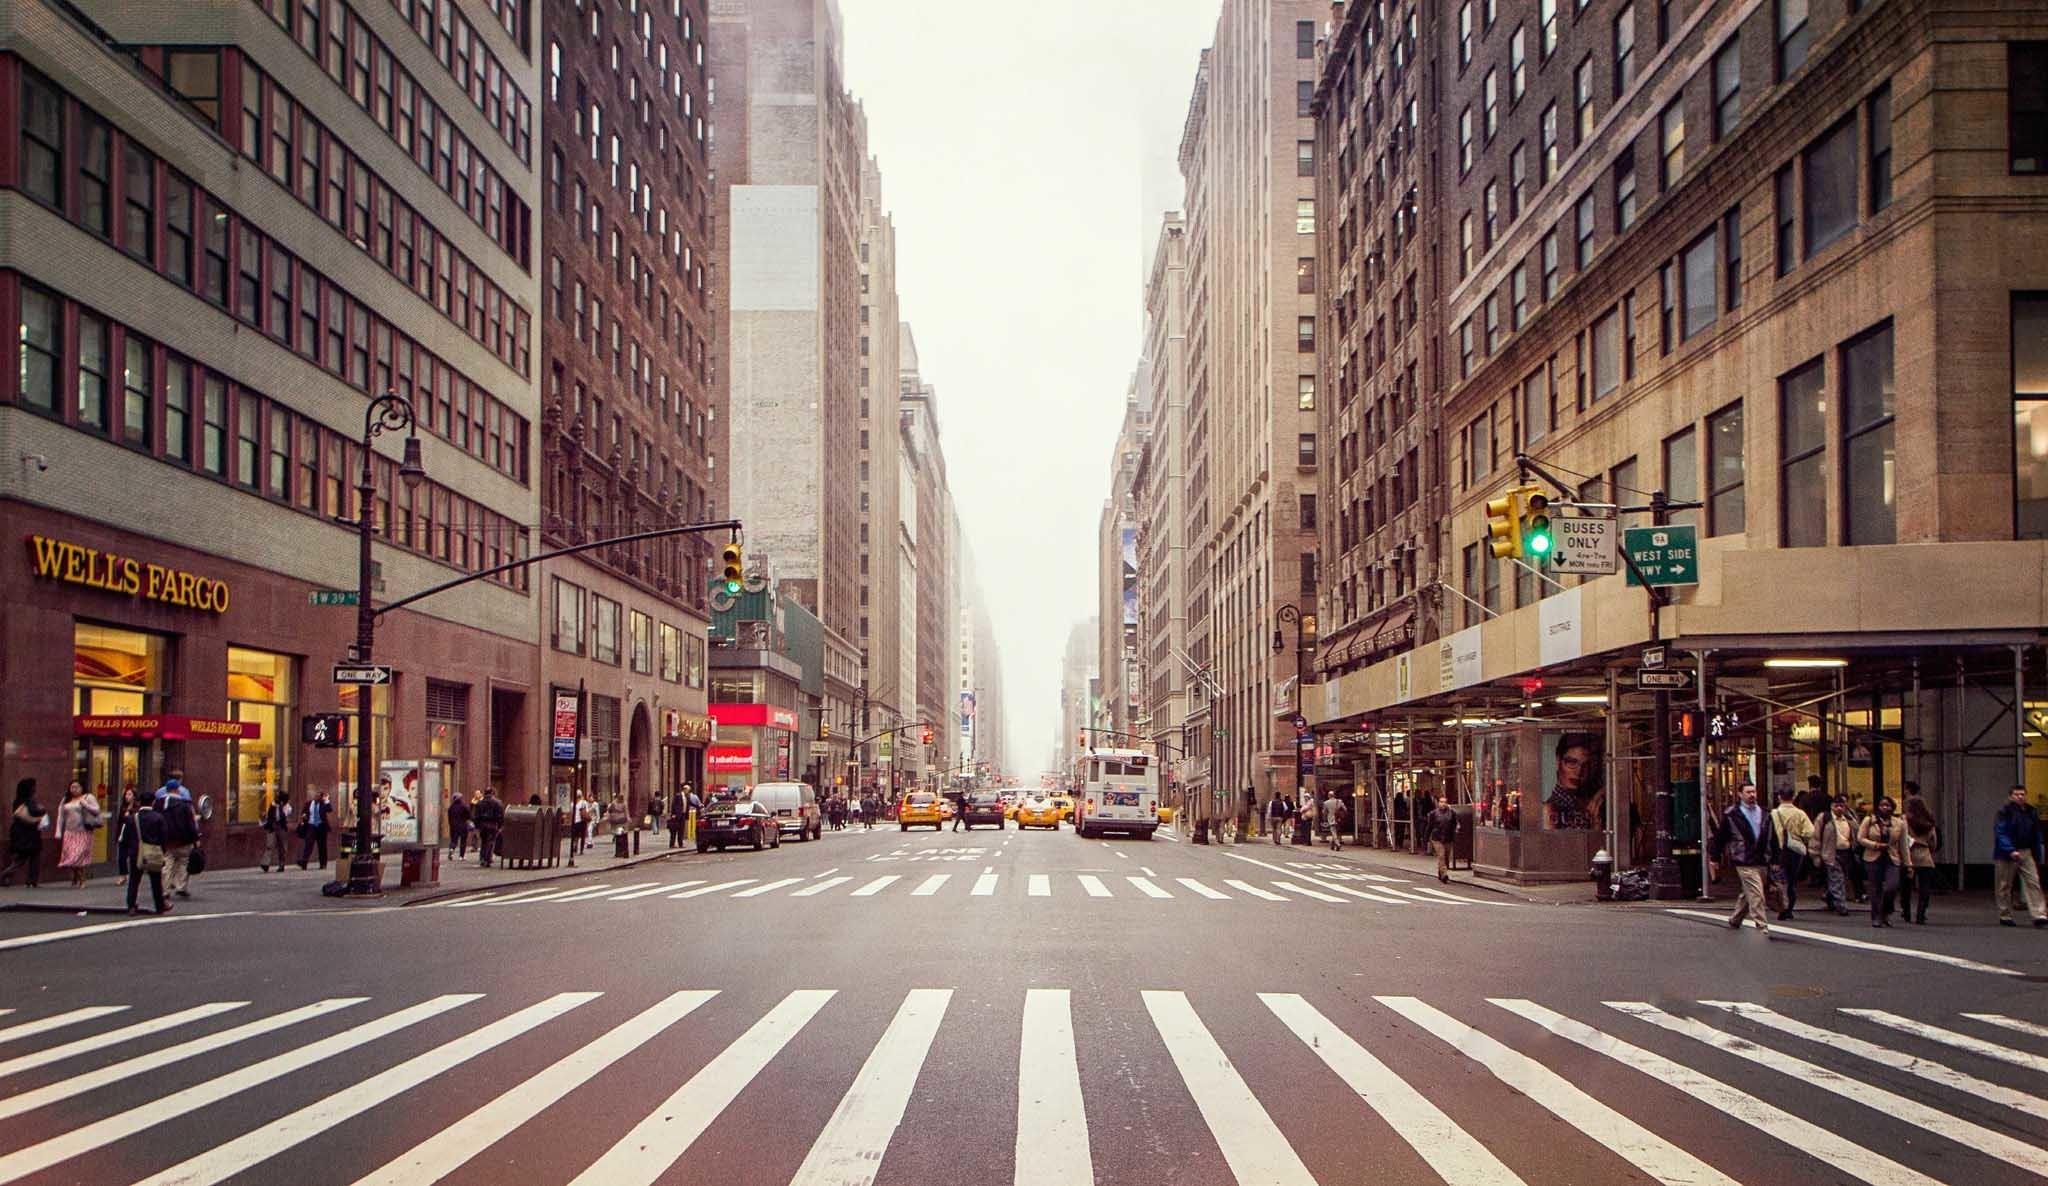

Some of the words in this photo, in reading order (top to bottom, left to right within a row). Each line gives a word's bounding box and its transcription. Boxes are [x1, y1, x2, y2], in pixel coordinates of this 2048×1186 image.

[1563, 523, 1604, 534] BUSES
[1567, 537, 1600, 549] ONLY
[1633, 550, 1661, 562] WEST
[1667, 548, 1692, 560] SIDE
[1569, 560, 1585, 568] MON
[33, 535, 140, 594] WELLS
[146, 563, 229, 613] FARGO
[332, 593, 345, 604] 39
[365, 671, 382, 679] WAY
[82, 719, 121, 729] WELLS
[122, 719, 158, 729] FARGO
[189, 719, 218, 733] WELLS
